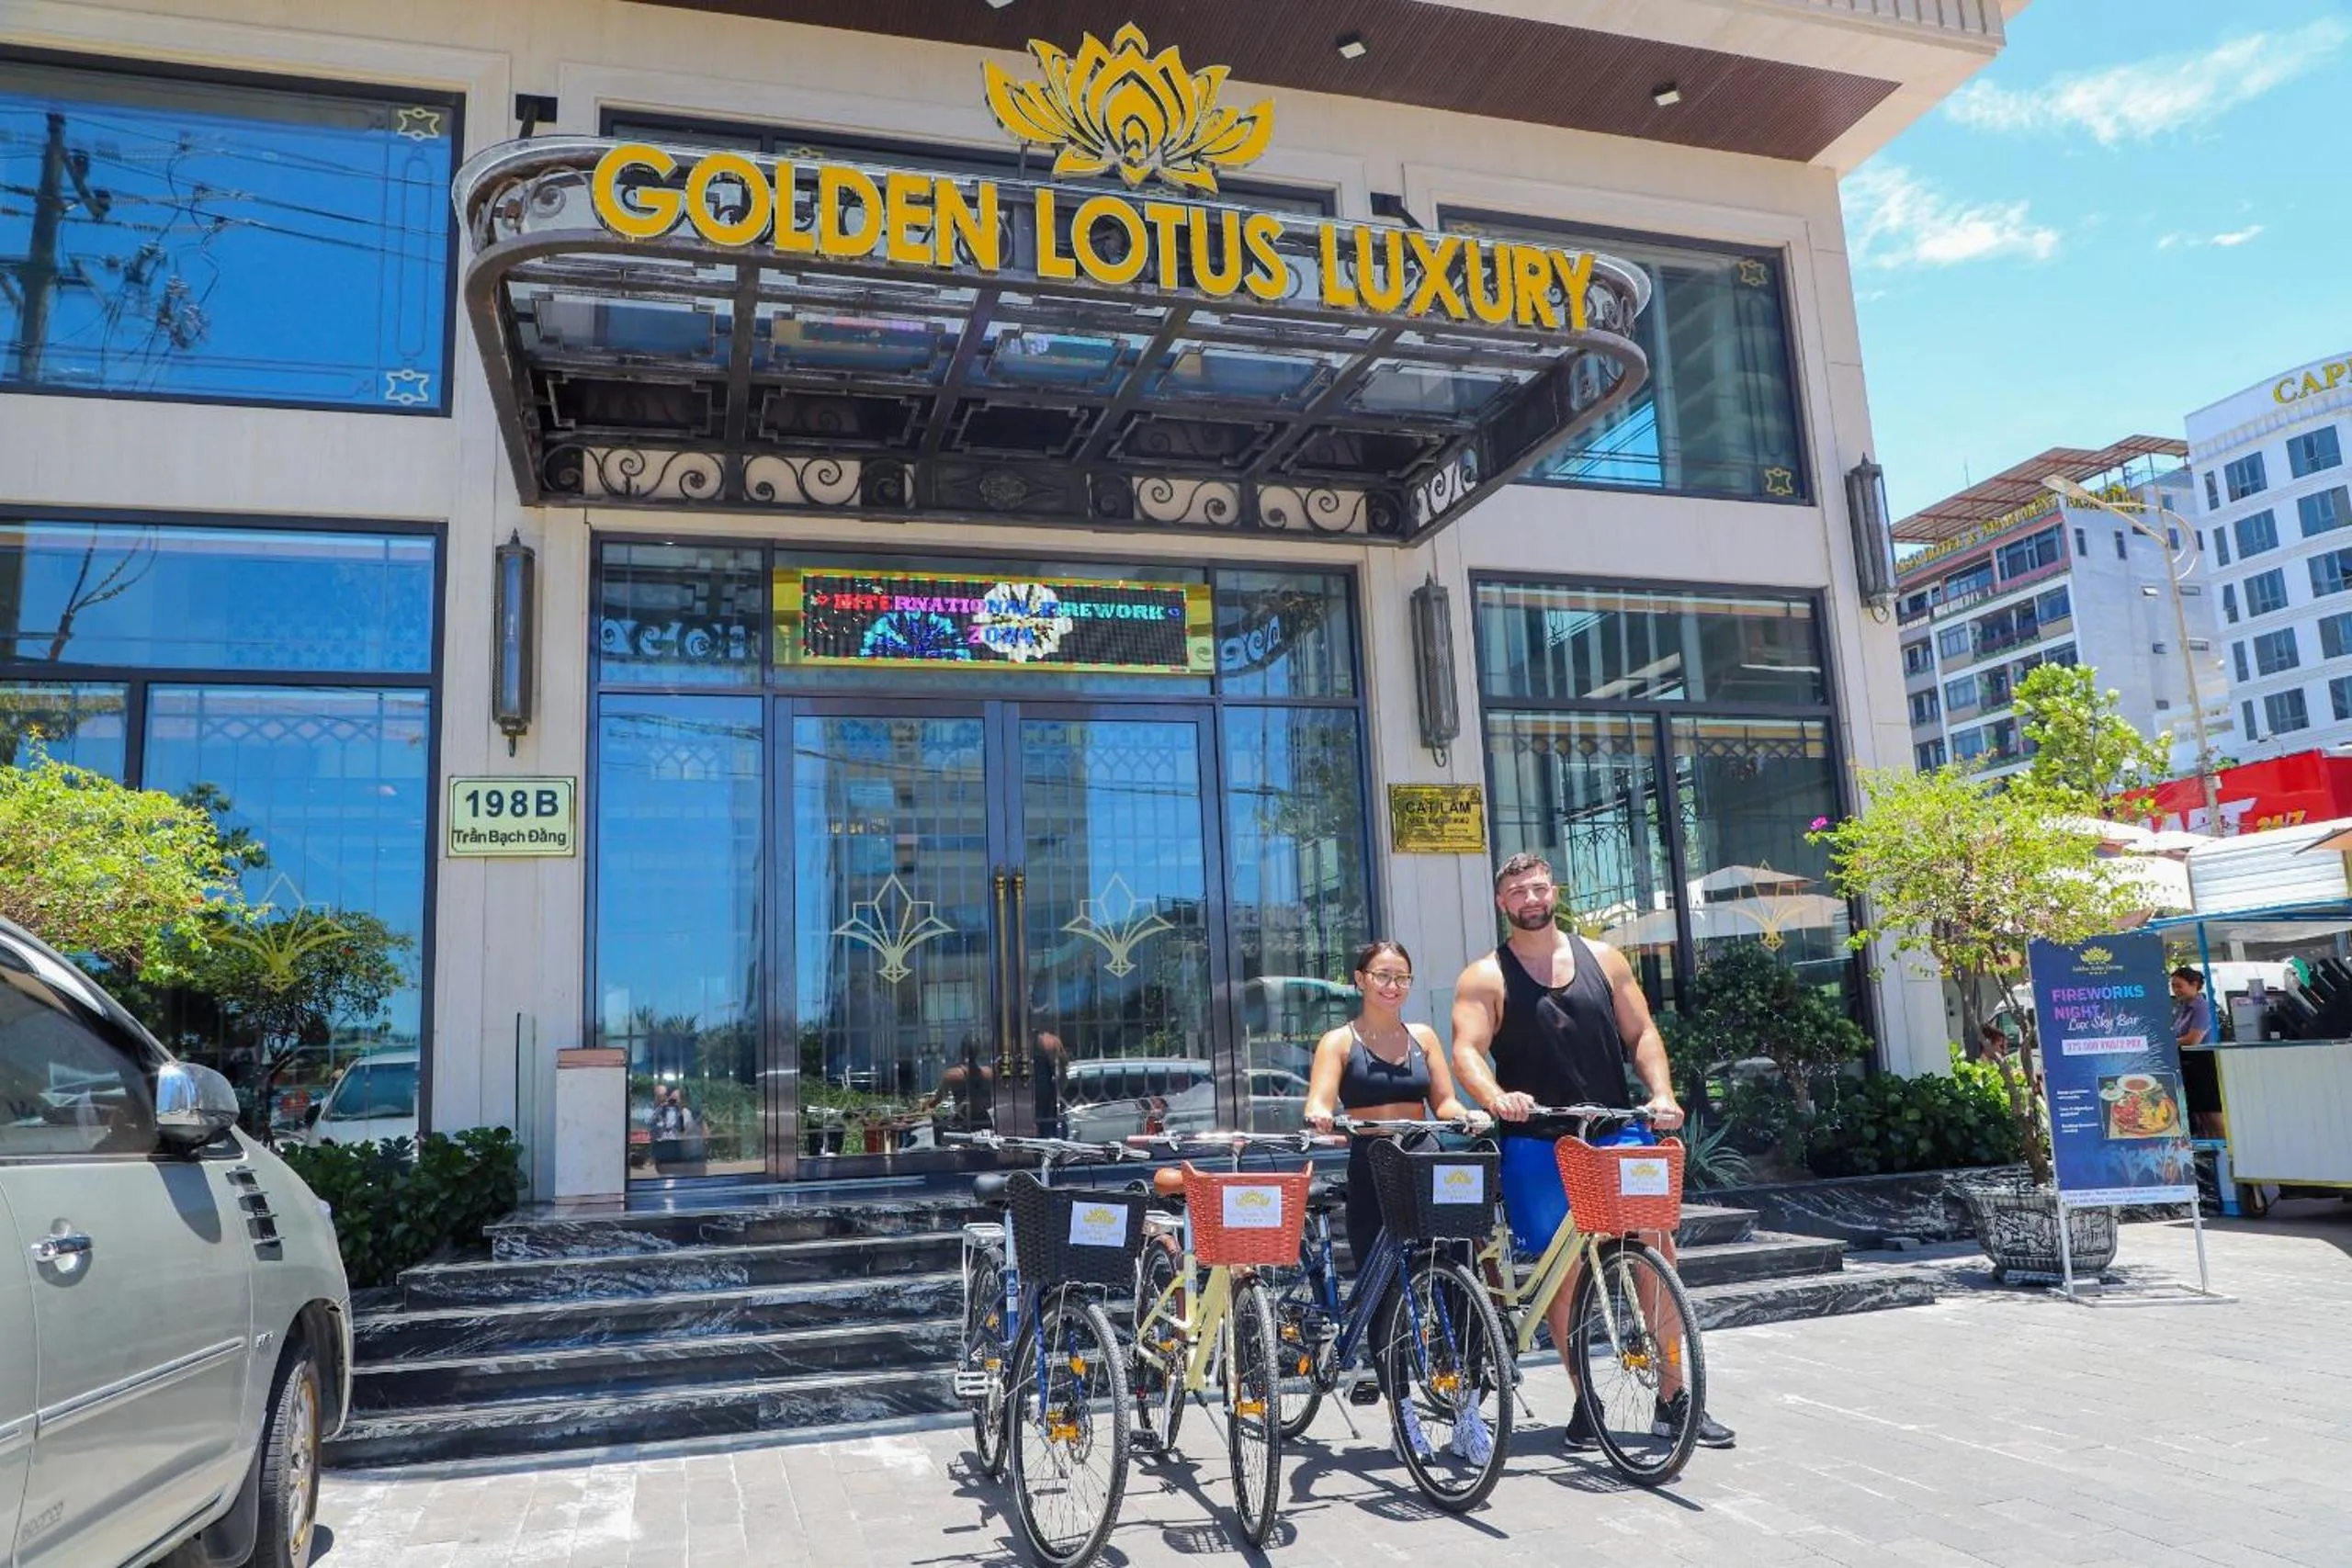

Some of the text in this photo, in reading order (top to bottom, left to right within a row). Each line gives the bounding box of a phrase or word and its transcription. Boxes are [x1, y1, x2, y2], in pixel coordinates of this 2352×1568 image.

[593, 143, 1594, 330] GOLDEN LOTUS LUXURY
[465, 789, 559, 818] 198B
[2052, 985, 2145, 1002] FIREWORKS
[2053, 1004, 2100, 1020] NIGHT
[2116, 1013, 2139, 1026] Bar
